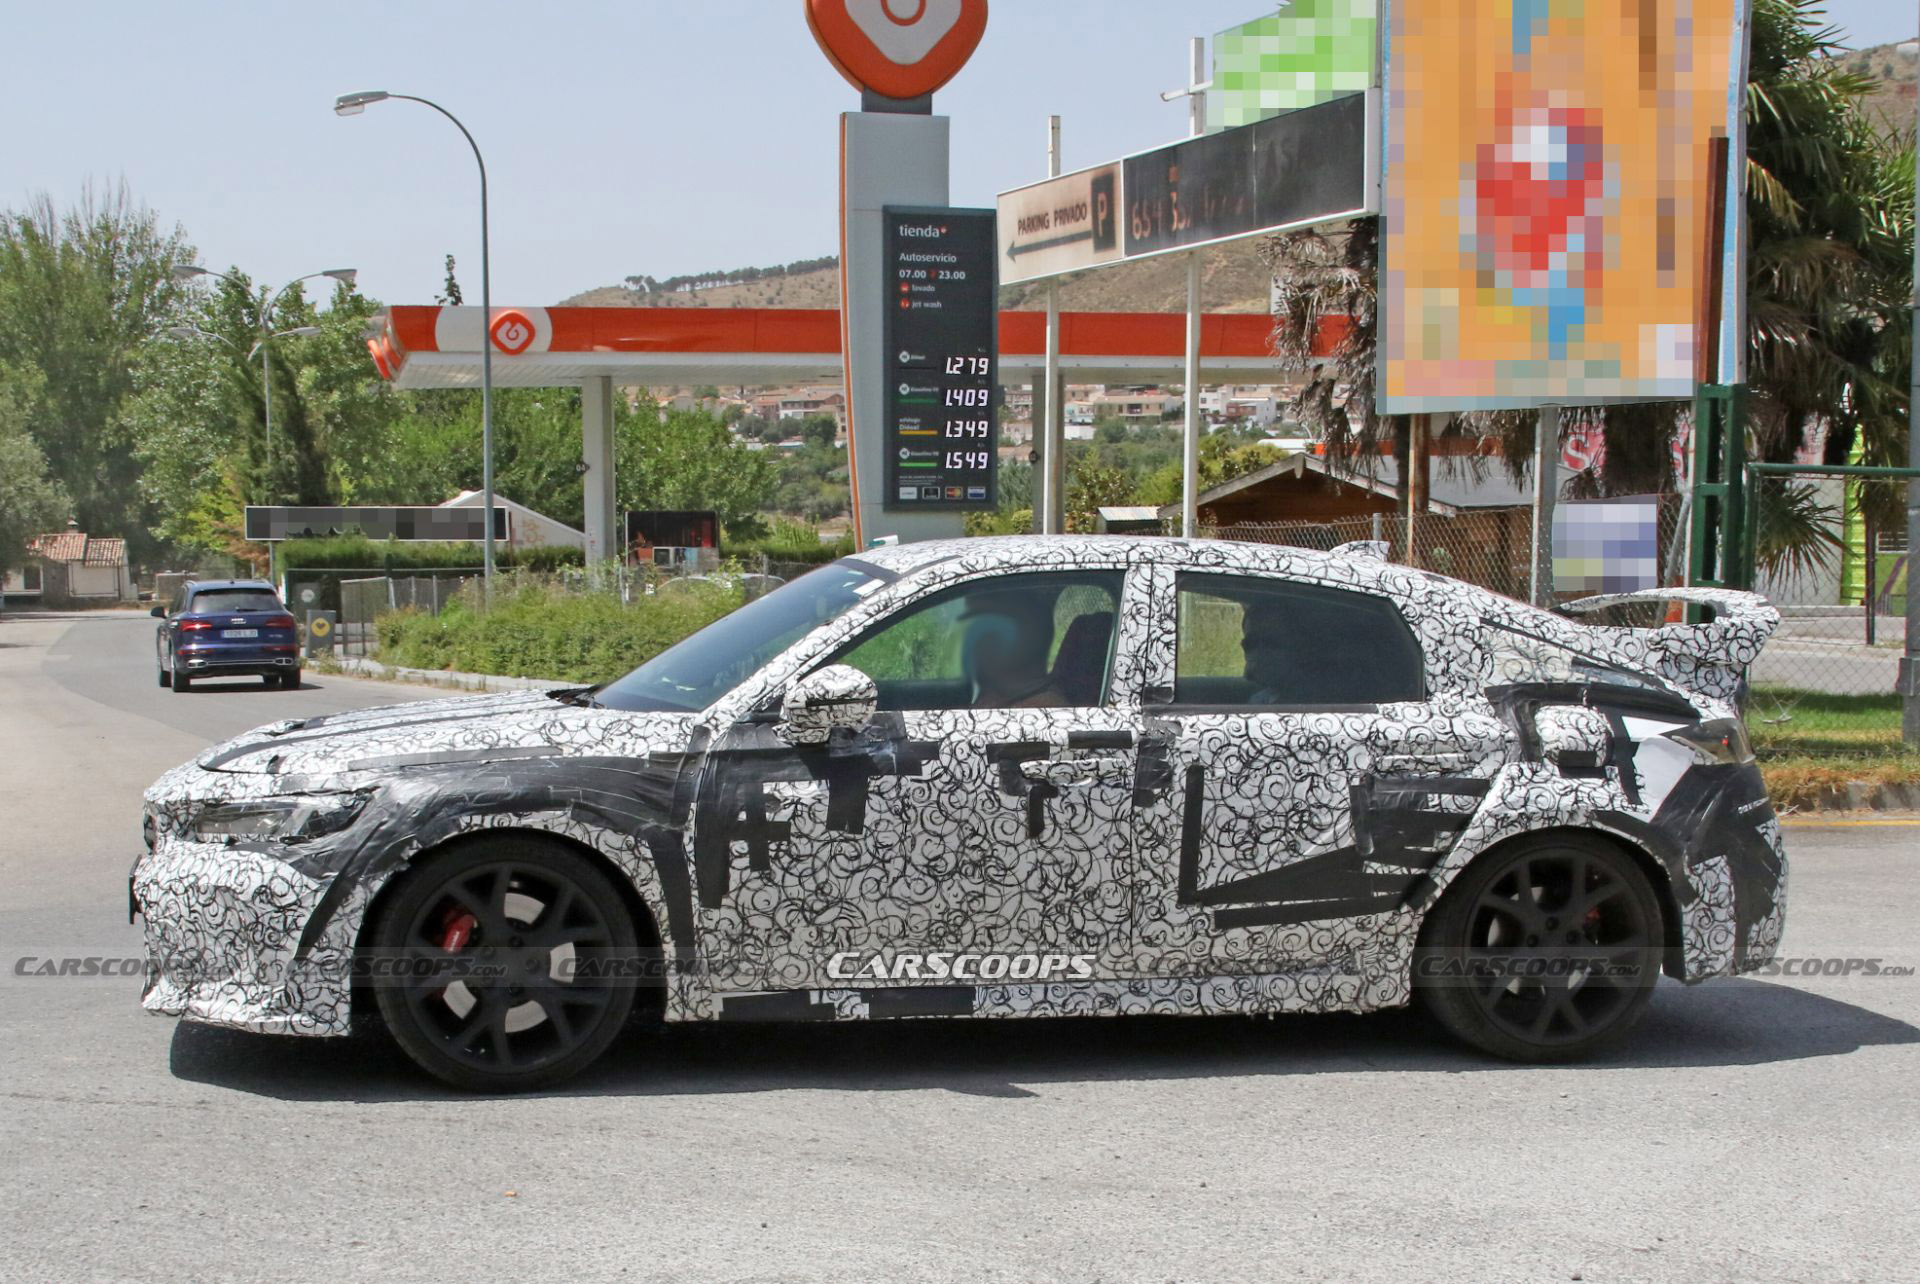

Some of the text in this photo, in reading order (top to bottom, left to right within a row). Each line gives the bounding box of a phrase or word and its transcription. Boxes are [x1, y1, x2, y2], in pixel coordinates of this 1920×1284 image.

[1017, 202, 1088, 236] PARKING PRIVADO
[1096, 191, 1108, 238] P
[899, 224, 940, 238] tienda
[899, 252, 957, 263] Autoservicio
[899, 269, 966, 280] 07.00 23.00
